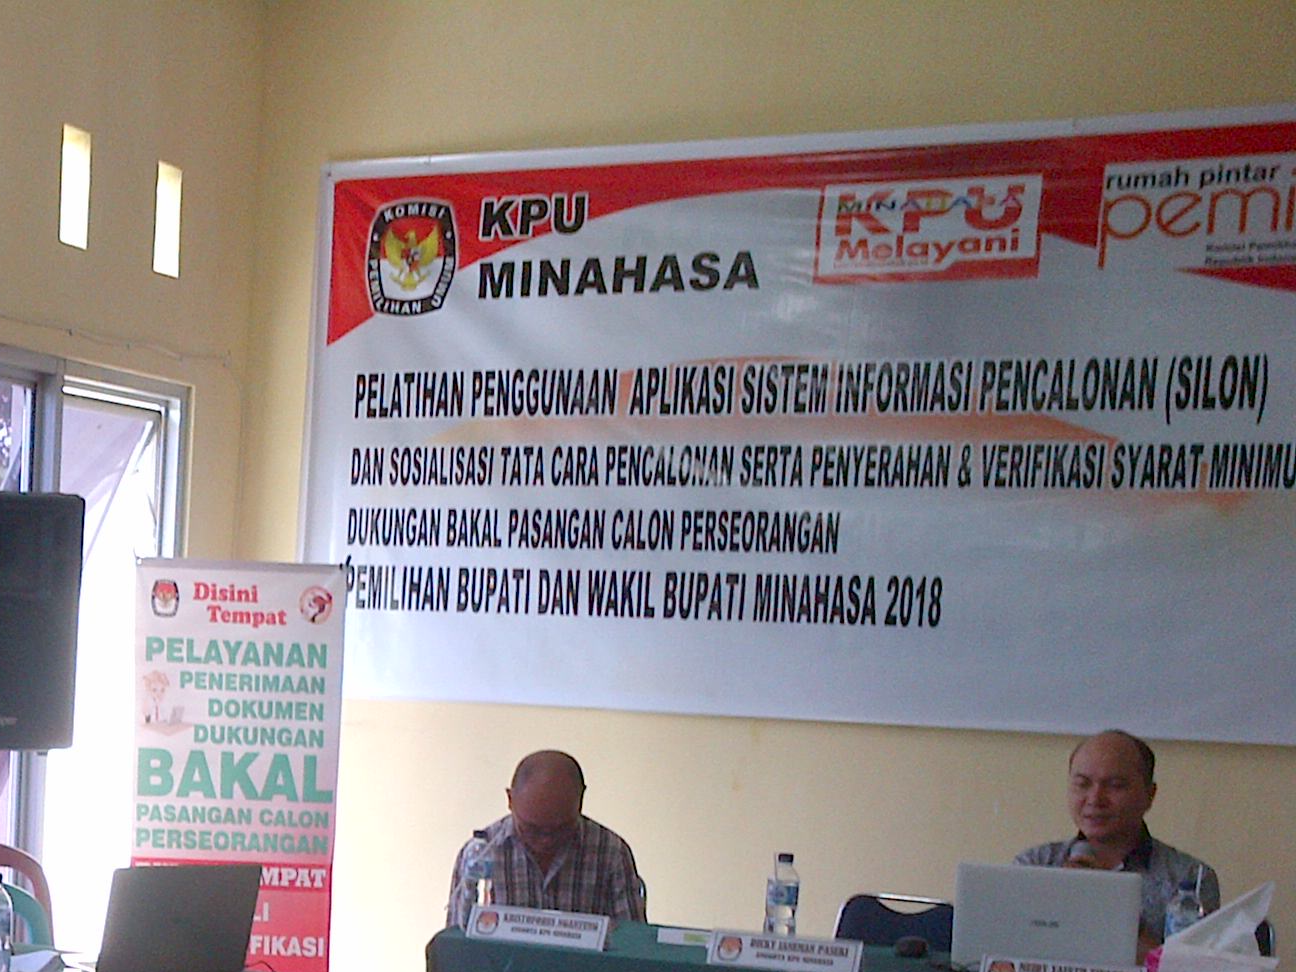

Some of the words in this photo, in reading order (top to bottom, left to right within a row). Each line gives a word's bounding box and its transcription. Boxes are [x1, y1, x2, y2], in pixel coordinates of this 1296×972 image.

[1106, 165, 1190, 190] rumah
[1199, 162, 1281, 189] pintar
[384, 203, 445, 222] KOMISI
[478, 193, 588, 240] KPU
[835, 184, 1026, 237] KPU
[1098, 186, 1296, 270] pemi
[835, 228, 1020, 264] Melayani
[478, 250, 760, 300] MINAHASA
[354, 370, 464, 419] PELATIHAN
[471, 367, 618, 418] PENGGUNAAN
[629, 365, 735, 416] APLIKASI
[740, 363, 828, 415] SISTEM
[835, 360, 972, 414] INFORMASI
[980, 358, 1158, 413] PENCALONAN
[1165, 354, 1269, 425] (SILON)
[350, 447, 384, 488] DAN
[389, 447, 495, 488] SOSIALISASI
[501, 446, 545, 487] TATA
[551, 446, 599, 487] CARA
[605, 445, 732, 488] PENCALONAN
[739, 445, 803, 488] SERTA
[810, 444, 951, 488] PENYERAHAN
[957, 445, 971, 488] &
[981, 444, 1104, 489] VERIFIKASI
[1111, 444, 1204, 489] SYARAT
[1209, 443, 1296, 490] MINIMU
[347, 508, 441, 547] DUKUNGAN
[447, 508, 502, 548] BAKAL
[508, 508, 605, 550] PASANGAN
[611, 510, 674, 552] CALON
[680, 510, 840, 555] PERSEORANGAN
[193, 582, 259, 604] Disini
[345, 565, 450, 612] PEMILIHAN
[456, 567, 531, 614] BUPATI
[538, 569, 579, 616] DAN
[587, 570, 655, 619] WAKIL
[663, 572, 746, 622] BUPATI
[753, 574, 876, 626] MINAHASA
[884, 576, 943, 629] 2018
[207, 605, 287, 628] Tempat
[145, 636, 328, 669] PELAYANAN
[179, 671, 326, 695] PENERIMAAN
[208, 698, 324, 721] DOKUMEN
[194, 723, 325, 748] DUKUNGAN
[137, 747, 334, 804] BAKAL
[136, 803, 253, 826] PASANGAN
[259, 807, 330, 829] CALON
[136, 827, 329, 855] PERSEORANGAN
[260, 866, 327, 889] MPAT
[249, 934, 325, 957] FIKASI
